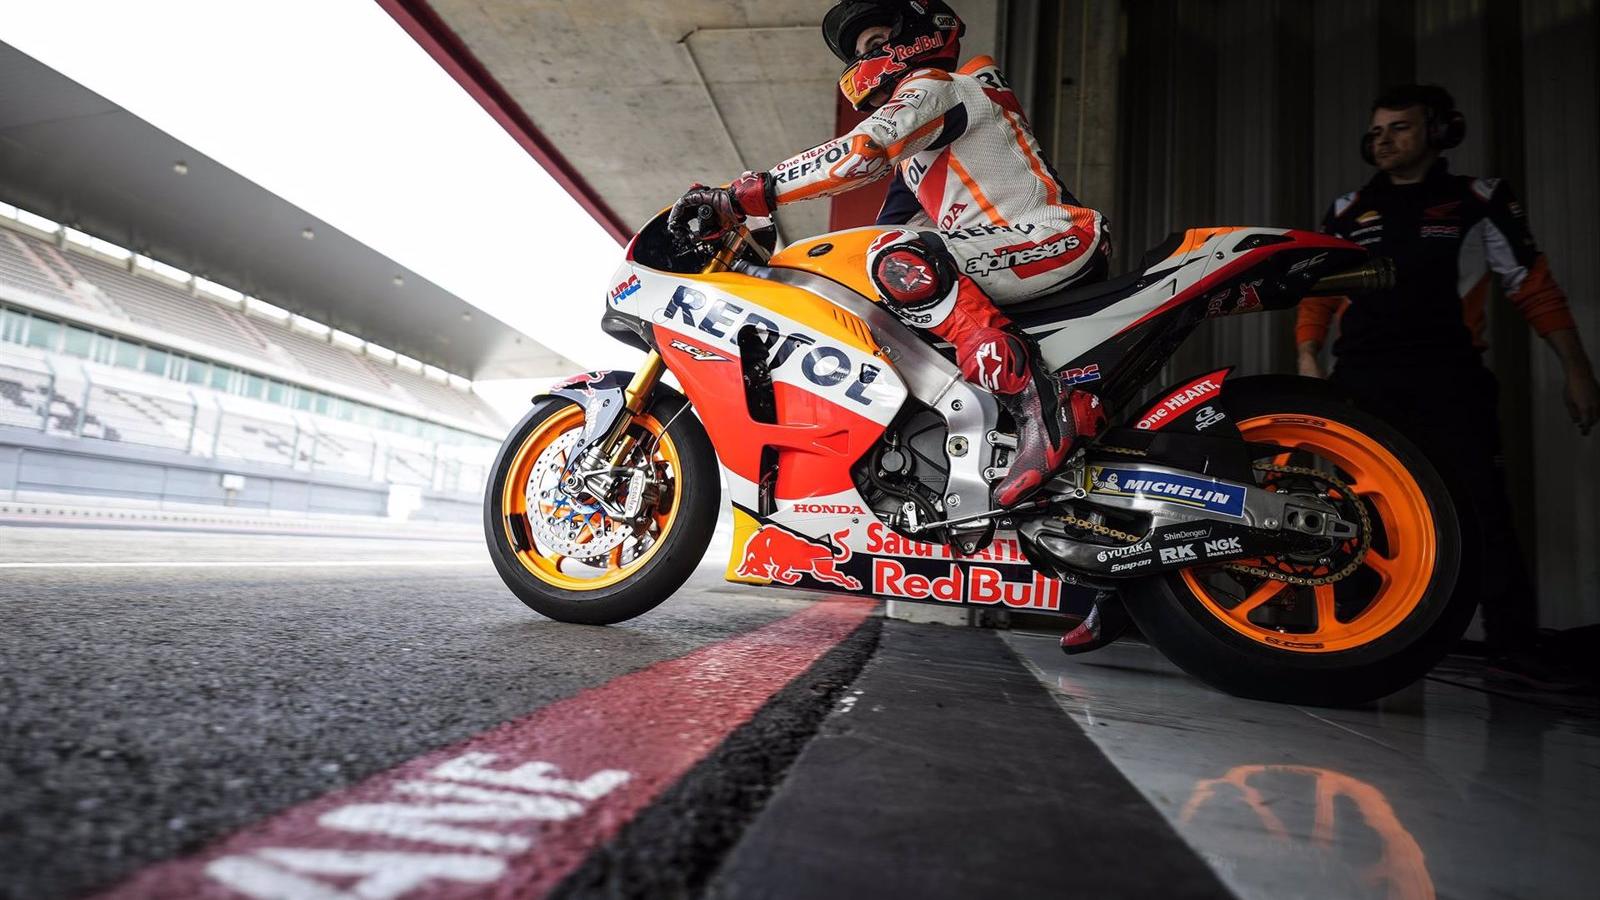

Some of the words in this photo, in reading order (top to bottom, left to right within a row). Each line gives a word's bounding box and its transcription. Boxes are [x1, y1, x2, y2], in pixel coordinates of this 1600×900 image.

[895, 36, 922, 61] Red
[920, 31, 944, 51] Bull
[776, 159, 800, 172] One
[801, 140, 840, 162] HEART
[965, 234, 1081, 277] alpinestars
[1136, 408, 1168, 430] One
[1195, 412, 1226, 431] RCB
[1123, 479, 1231, 505] MICHELIN
[793, 504, 866, 515] HONDA
[1163, 529, 1207, 541] ShinDengen
[1204, 536, 1242, 553] NGK
[1107, 541, 1152, 559] YUTAKA
[1159, 543, 1197, 561] RK
[1110, 558, 1152, 573] Snap-on
[872, 557, 965, 603] Red
[967, 565, 1062, 611] Bull
